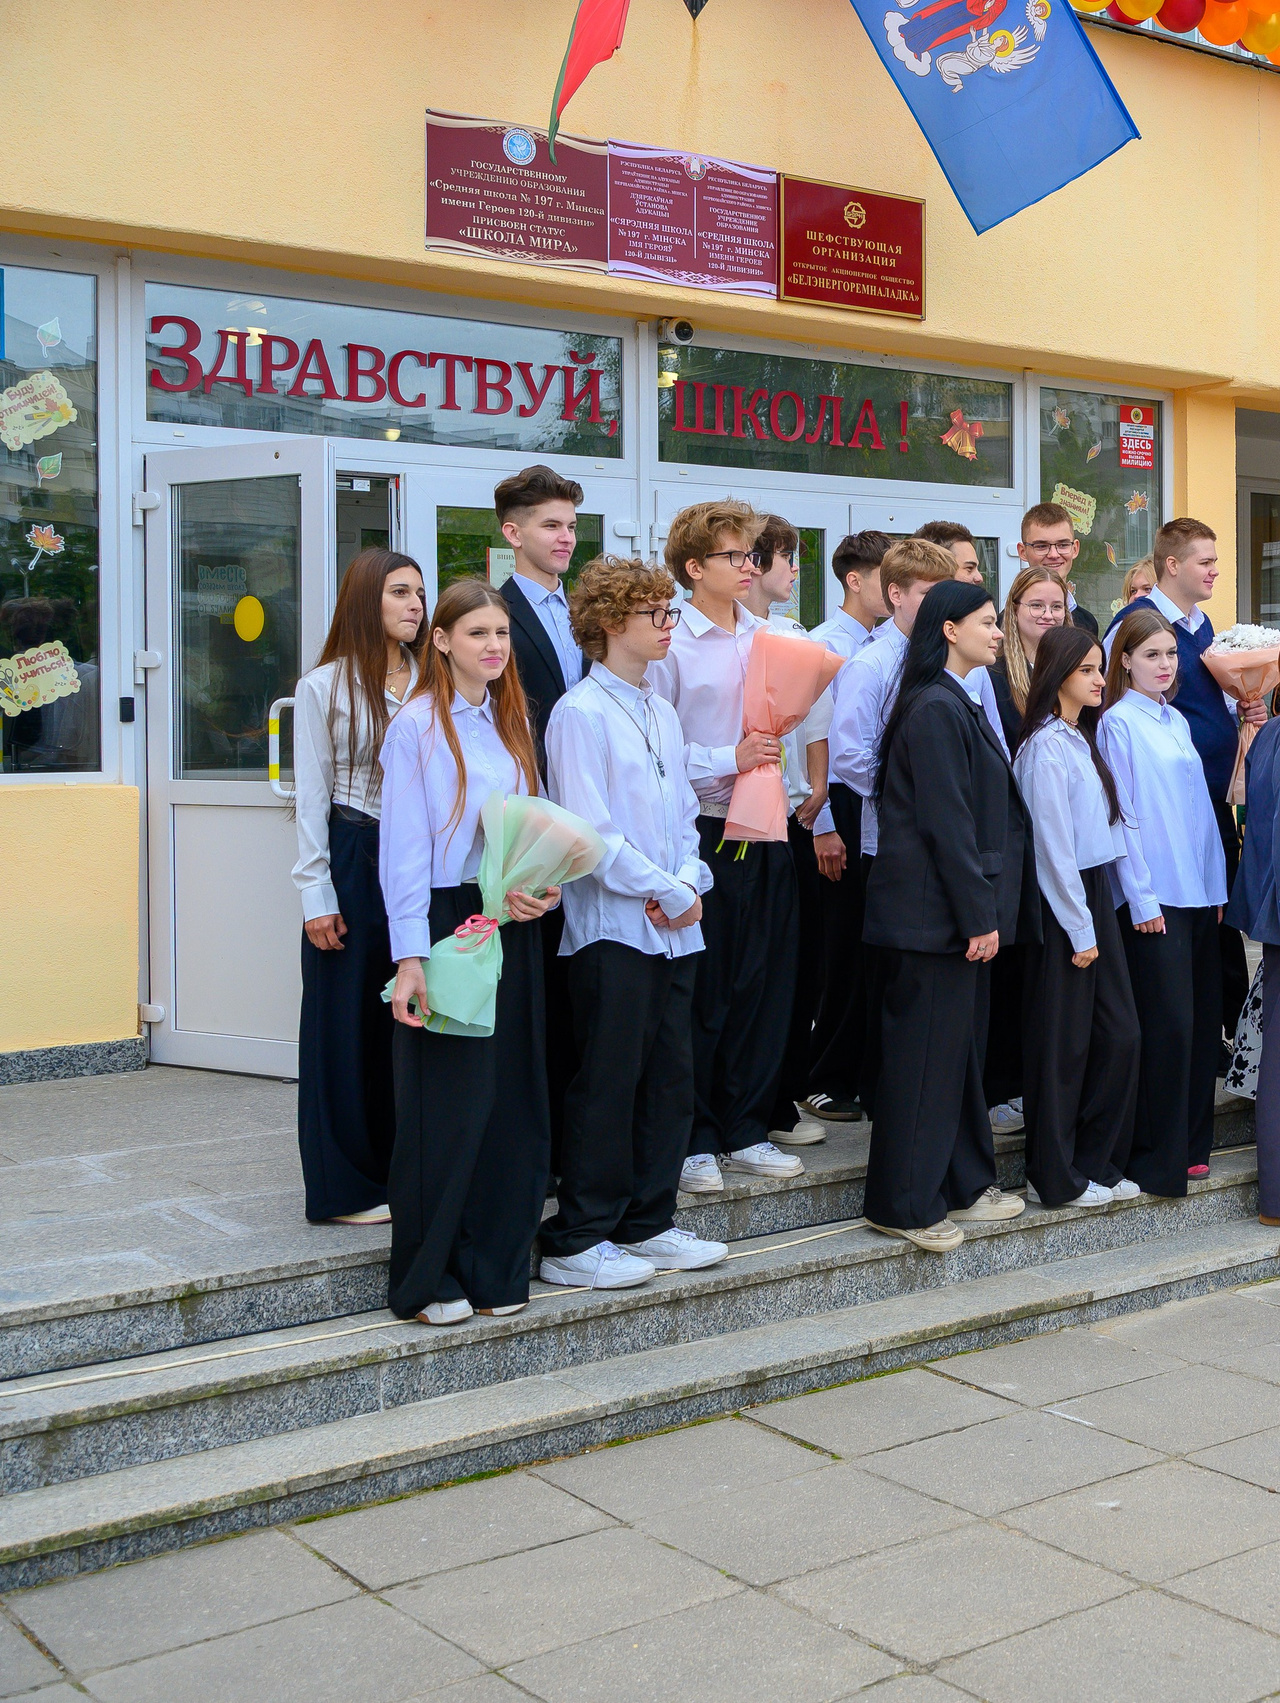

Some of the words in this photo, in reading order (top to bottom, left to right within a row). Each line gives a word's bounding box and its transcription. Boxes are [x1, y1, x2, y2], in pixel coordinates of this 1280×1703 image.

[471, 160, 567, 183] ГОСУДАРСТВЕННОМУ
[655, 167, 682, 176] БЕЛАРУСЬ
[451, 168, 518, 186] УЧРЕЖДЕНИЮ
[520, 179, 585, 197] ОБРАЗОВАНИЯ
[742, 182, 767, 190] БЕЛАРУСЬ
[429, 179, 480, 195] «Средняя
[484, 191, 517, 201] школа
[520, 193, 531, 203] №
[534, 195, 553, 207] 197
[556, 201, 563, 209] г.
[566, 201, 605, 216] Минска
[630, 193, 673, 204] ДЗЯРЖАЎНАЯ
[441, 198, 475, 209] имени
[479, 201, 515, 215] Героев
[519, 208, 544, 219] 120-й
[547, 214, 594, 227] дивизии»
[710, 207, 766, 221] ГОСУДАРСТВЕННОЕ
[718, 215, 758, 226] УЧРЕЖДЕНИЕ
[473, 216, 526, 231] ПРИСВОЕН
[529, 224, 565, 236] СТАТУС
[610, 217, 659, 231] «СЯРЭДНЯЯ
[662, 225, 693, 236] ШКОЛА
[716, 222, 758, 233] ОБРАЗОВАНИЯ
[459, 226, 524, 245] «ШКОЛА
[529, 238, 578, 253] МИРА»
[618, 228, 626, 236] №
[652, 234, 686, 246] МІНСКА
[698, 231, 742, 244] «СРЕДНЯЯ
[744, 238, 774, 249] ШКОЛА
[806, 230, 902, 255] ШЕФСТВУЮЩАЯ
[625, 250, 642, 258] 120-Й
[644, 243, 673, 252] ГЕРОЯЎ
[712, 243, 723, 251] 197
[735, 247, 770, 258] МИНСКА
[812, 246, 896, 267] ОРГАНИЗАЦИЯ
[709, 252, 734, 262] ИМЕНИ
[736, 256, 762, 266] ГЕРОЕВ
[708, 262, 725, 270] 120-Й
[726, 265, 763, 275] ДИВИЗИИ»
[793, 262, 827, 272] ОТКРЫТОЕ
[831, 268, 877, 280] АКЦИОНЕРНОЕ
[881, 275, 914, 285] ОБЩЕСТВО
[788, 273, 919, 302] «БЕЛЭНЕРГОРЕМНАЛАДКА»
[150, 315, 618, 438] ЗДРАВСТВУЙ,
[6, 384, 34, 401] Буду
[1122, 438, 1151, 450] ЗДЕСЬ
[1122, 459, 1152, 467] МИЛИЦИЮ
[16, 648, 60, 669] Люблю
[19, 656, 67, 683] учиться!
